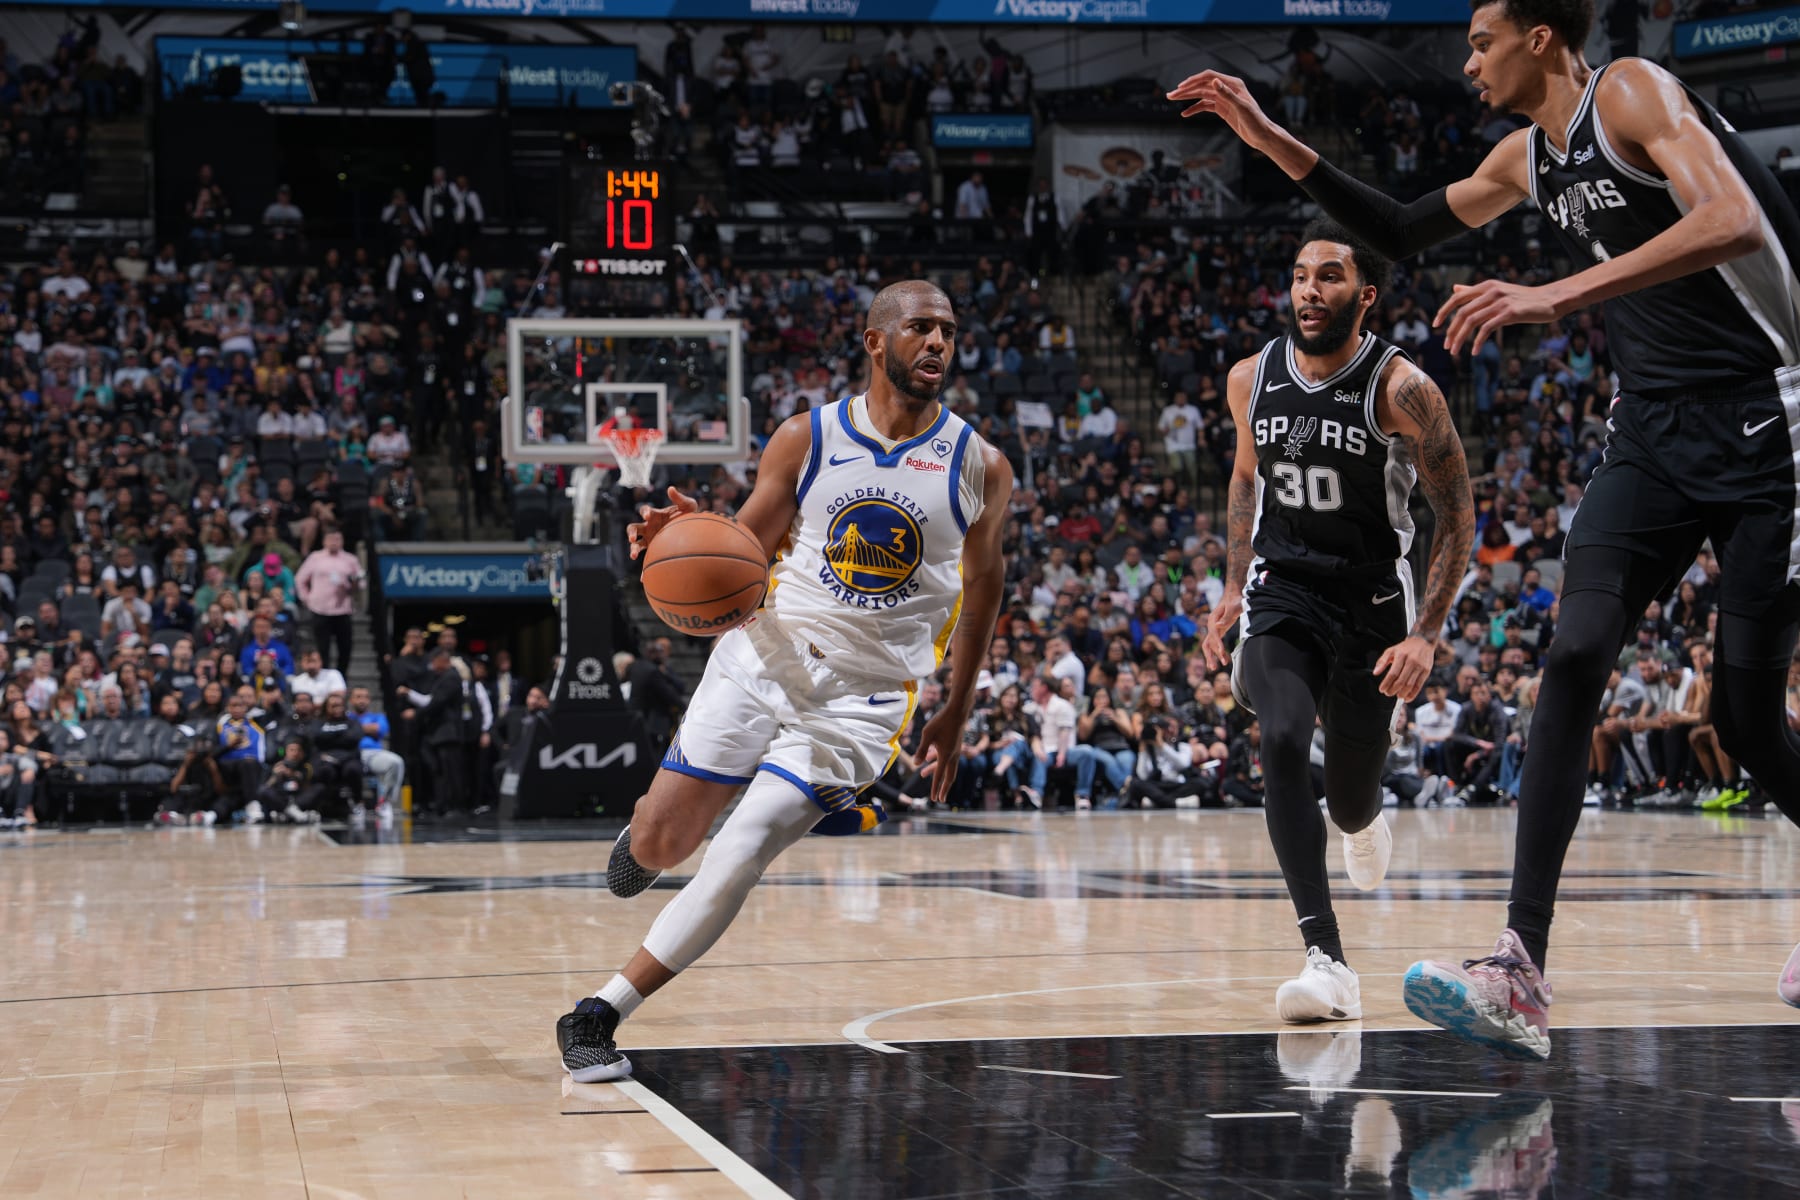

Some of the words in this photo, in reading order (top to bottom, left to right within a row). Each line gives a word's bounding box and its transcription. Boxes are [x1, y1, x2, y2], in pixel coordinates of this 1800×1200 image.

[1344, 0, 1392, 20] today
[560, 67, 609, 90] today
[607, 170, 659, 199] 1:44
[606, 200, 653, 250] 10
[599, 259, 667, 275] TISSOT
[1255, 415, 1368, 460] SPURS
[906, 456, 945, 472] Rakuten
[1271, 461, 1344, 512] 30
[826, 486, 886, 515] GOLDEN
[891, 491, 929, 526] STATE
[888, 527, 907, 553] 3
[818, 565, 920, 610] WARRIORS
[659, 607, 741, 630] Wilson
[568, 680, 610, 699] Frost
[539, 742, 637, 770] KIA
